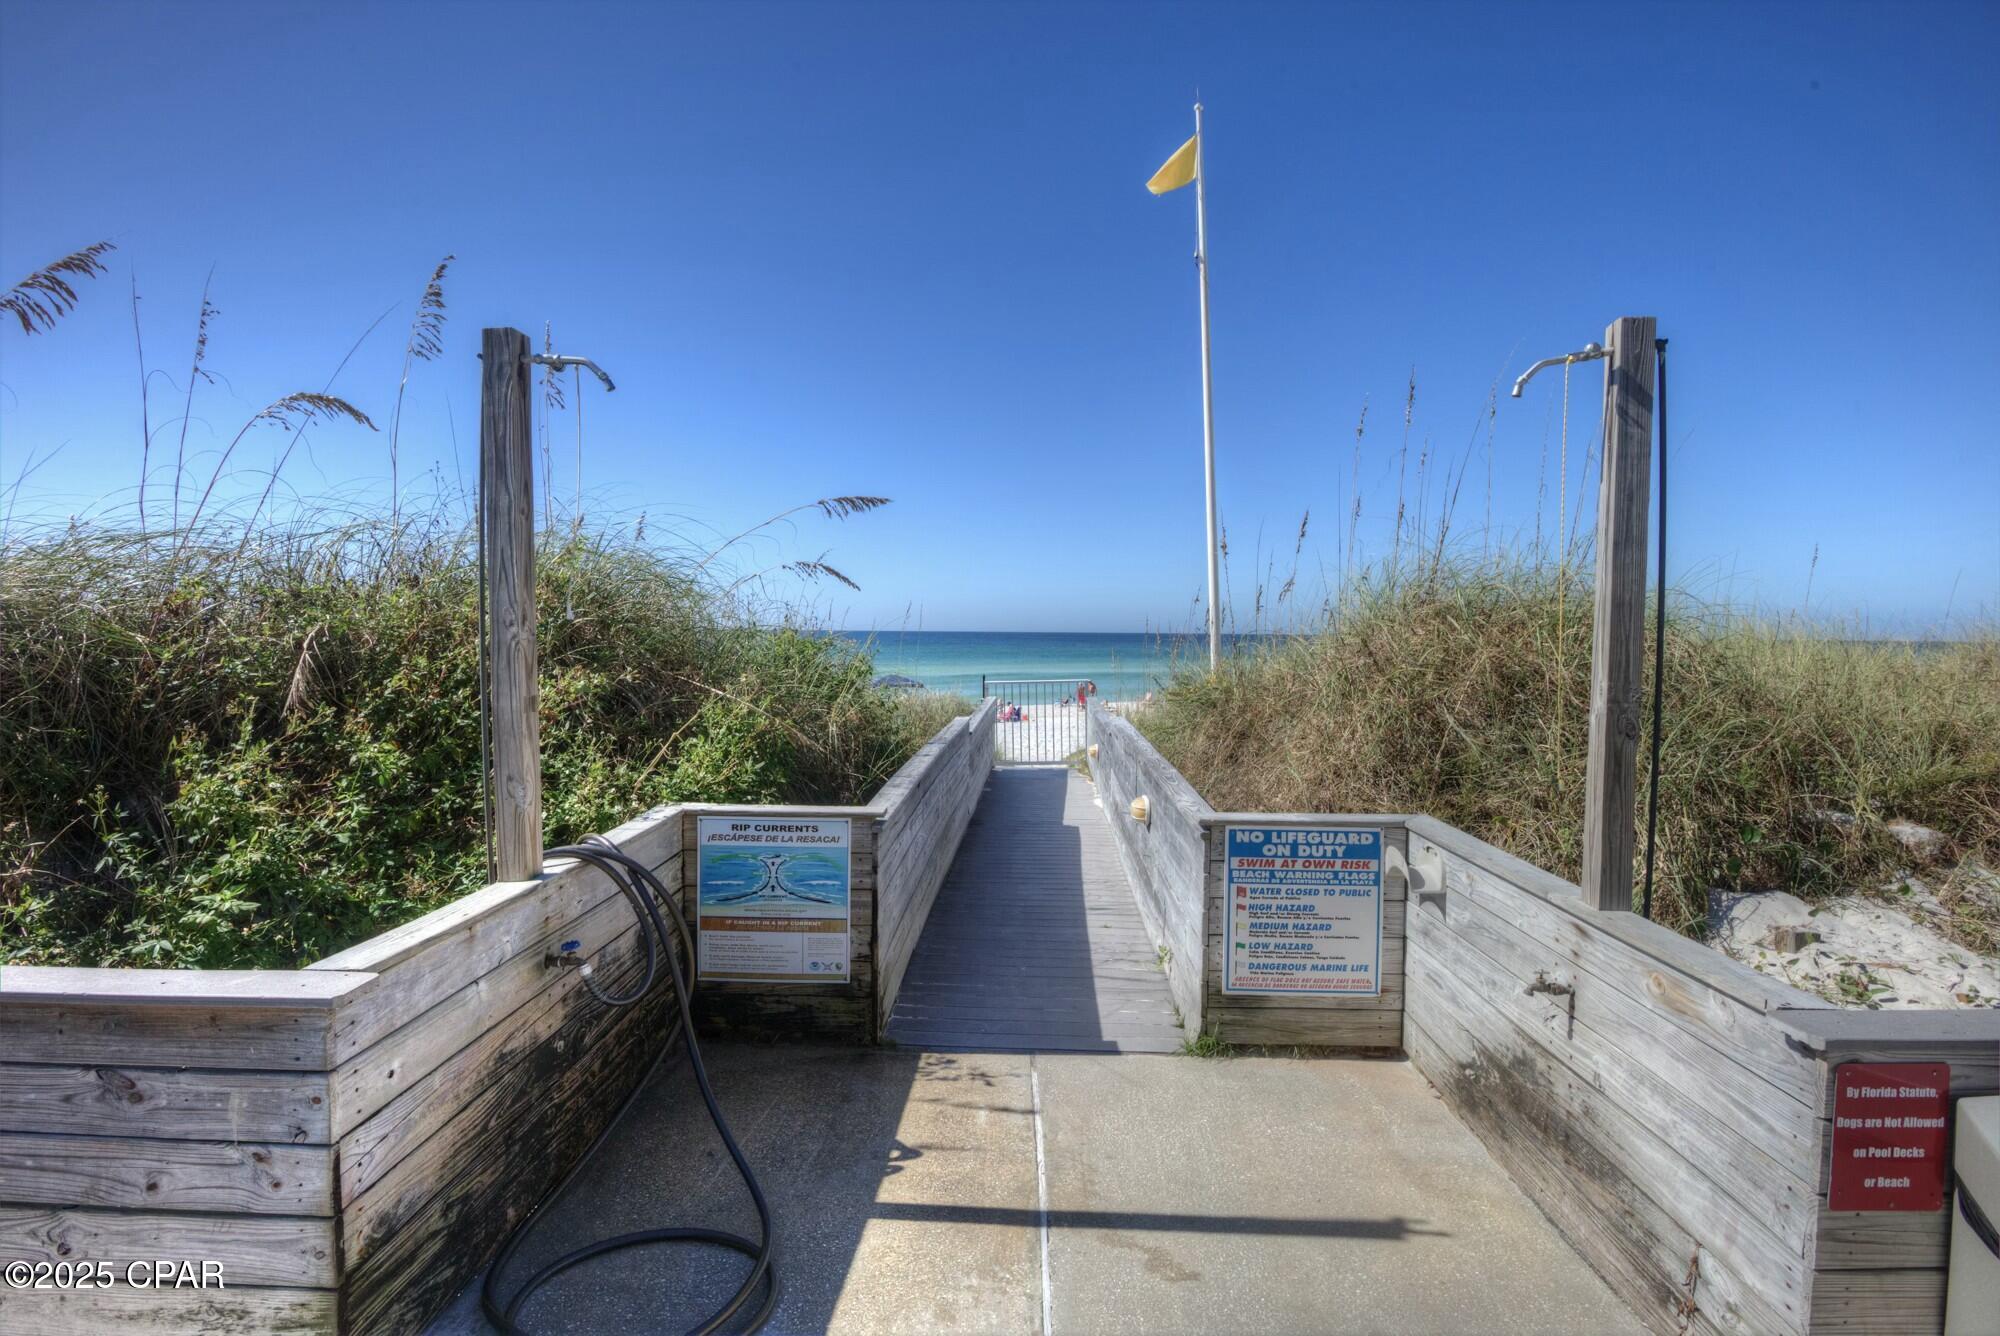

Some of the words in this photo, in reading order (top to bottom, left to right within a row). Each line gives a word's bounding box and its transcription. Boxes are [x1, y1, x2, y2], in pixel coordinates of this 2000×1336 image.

[731, 823, 751, 832] RIP
[754, 824, 819, 833] CURRENTS
[765, 834, 779, 843] DE
[781, 835, 794, 843] LA
[796, 835, 841, 844] RESACA!
[1235, 831, 1265, 843] NO
[1271, 832, 1374, 845] LIFEGUARD
[1262, 844, 1292, 857] ON
[1298, 845, 1347, 858] DUTY
[1237, 858, 1276, 868] SWIM
[1280, 859, 1298, 869] AT
[1302, 859, 1336, 869] OWN
[1340, 860, 1371, 870] RISK
[1231, 870, 1270, 878] BEACH
[1274, 871, 1334, 879] WARNING
[1338, 872, 1376, 880] FLAGS
[1249, 887, 1282, 895] WATER
[1285, 887, 1320, 896] CLOSED
[1323, 888, 1336, 896] TO
[1338, 888, 1372, 897] PUBLIC
[1248, 903, 1272, 911] HIGH
[1275, 904, 1315, 912] HAZARD
[1249, 922, 1289, 930] MEDIUM
[1291, 923, 1332, 931] HAZARD
[1248, 942, 1270, 950] LOW
[1273, 942, 1314, 951] HAZARD
[1248, 962, 1307, 971] DANGEROUS
[1310, 963, 1347, 972] MARINE
[1350, 964, 1370, 973] LIFE
[1846, 1087, 1859, 1099] By
[1861, 1087, 1897, 1098] Florida
[1899, 1087, 1939, 1099] Statute,
[1836, 1117, 1863, 1129] Dogs
[1864, 1118, 1882, 1128] are
[1884, 1117, 1902, 1128] Not
[1903, 1117, 1945, 1128] Allowed
[1853, 1148, 1867, 1158] on
[1868, 1147, 1891, 1158] Pool
[1893, 1147, 1925, 1158] Decks
[1864, 1178, 1876, 1188] or
[1877, 1176, 1911, 1188] Beach
